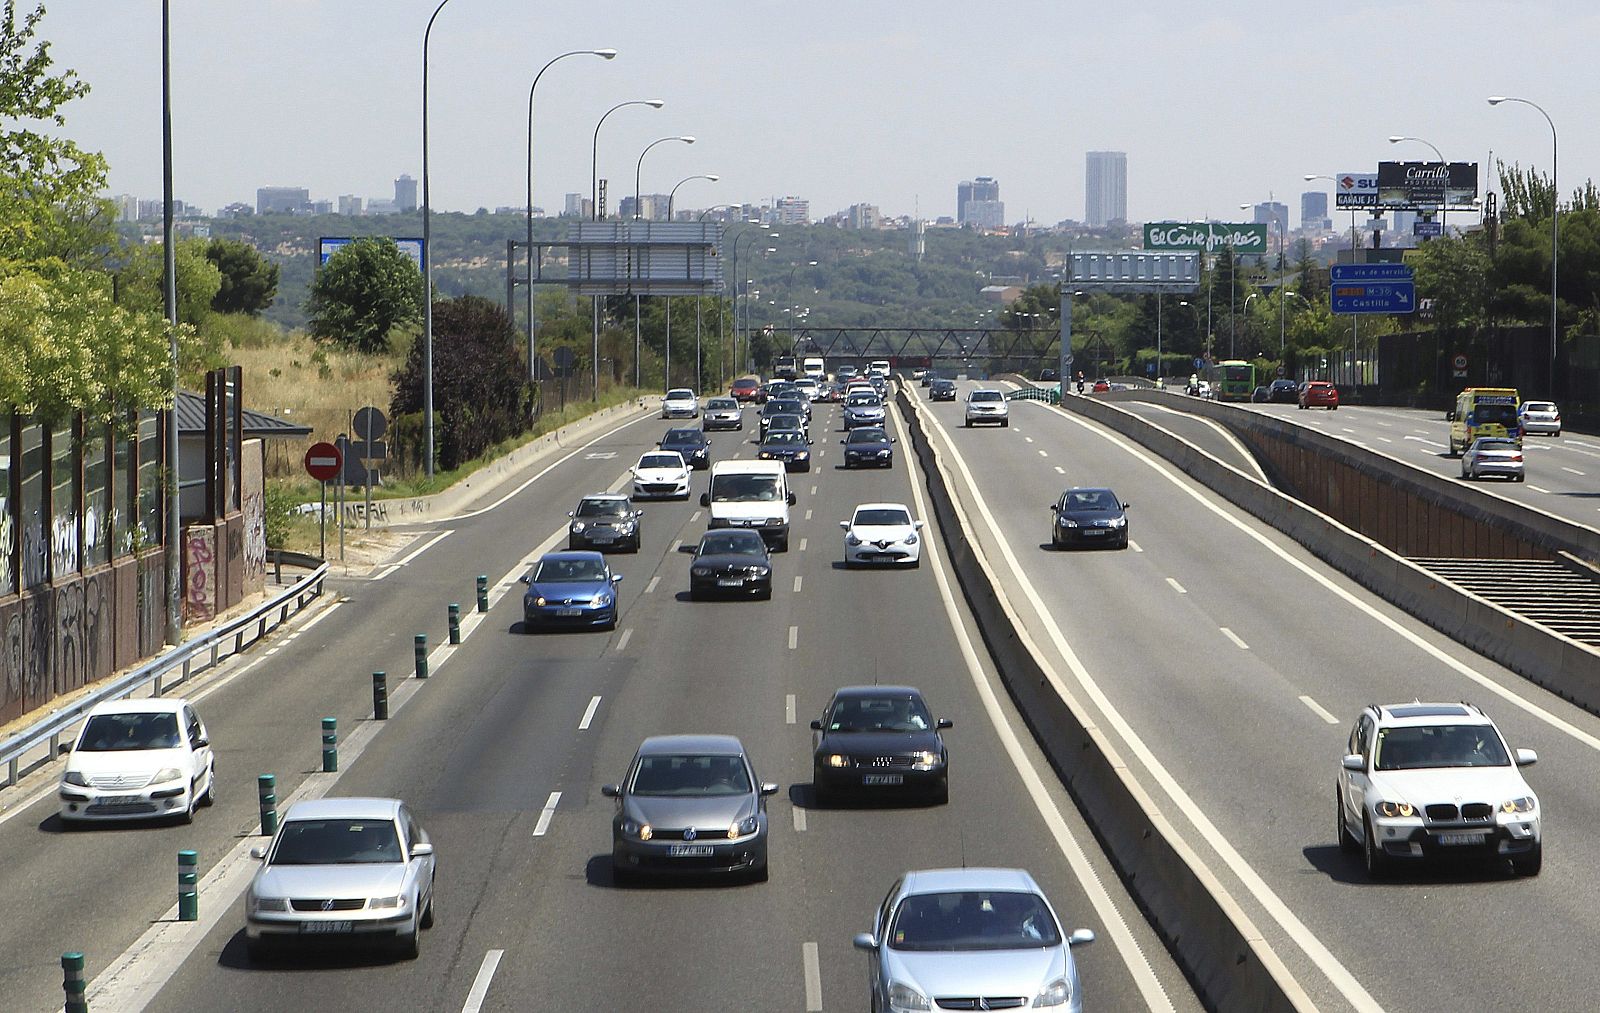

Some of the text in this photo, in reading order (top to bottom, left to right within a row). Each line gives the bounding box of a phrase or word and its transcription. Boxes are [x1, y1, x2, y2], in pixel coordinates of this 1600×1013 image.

[1406, 166, 1450, 179] Carrillo
[1338, 195, 1366, 205] GARAJE
[1149, 227, 1166, 246] El
[1166, 226, 1205, 246] Corte
[1352, 299, 1390, 307] Castilla
